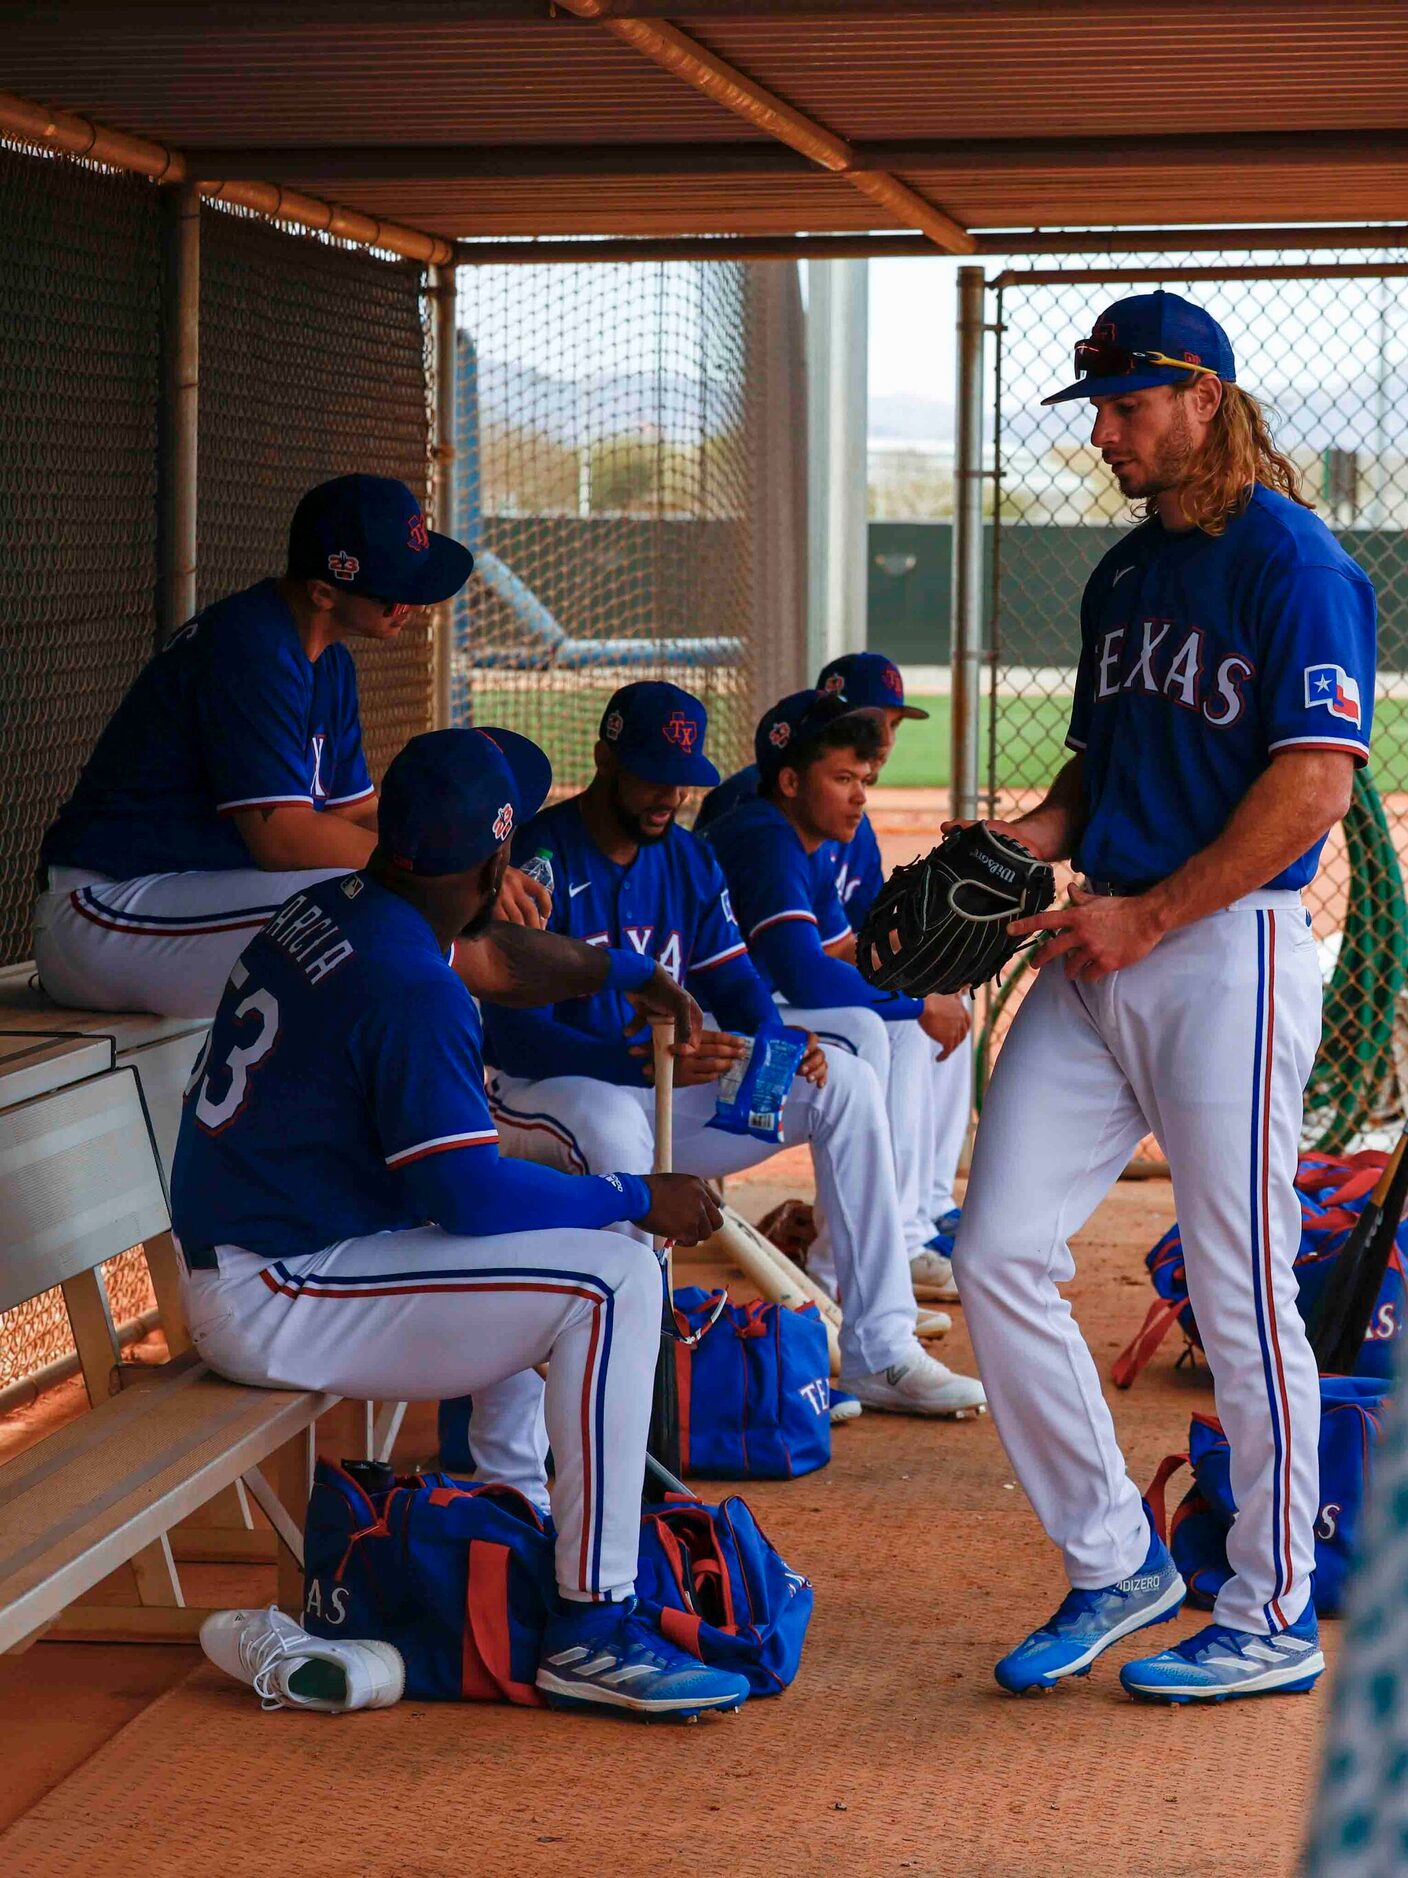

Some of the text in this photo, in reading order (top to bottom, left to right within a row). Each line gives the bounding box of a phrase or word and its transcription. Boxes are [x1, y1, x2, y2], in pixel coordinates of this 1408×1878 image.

[1093, 618, 1255, 729] EXAS
[975, 848, 1016, 883] Wilson
[262, 895, 355, 986] ARCIA
